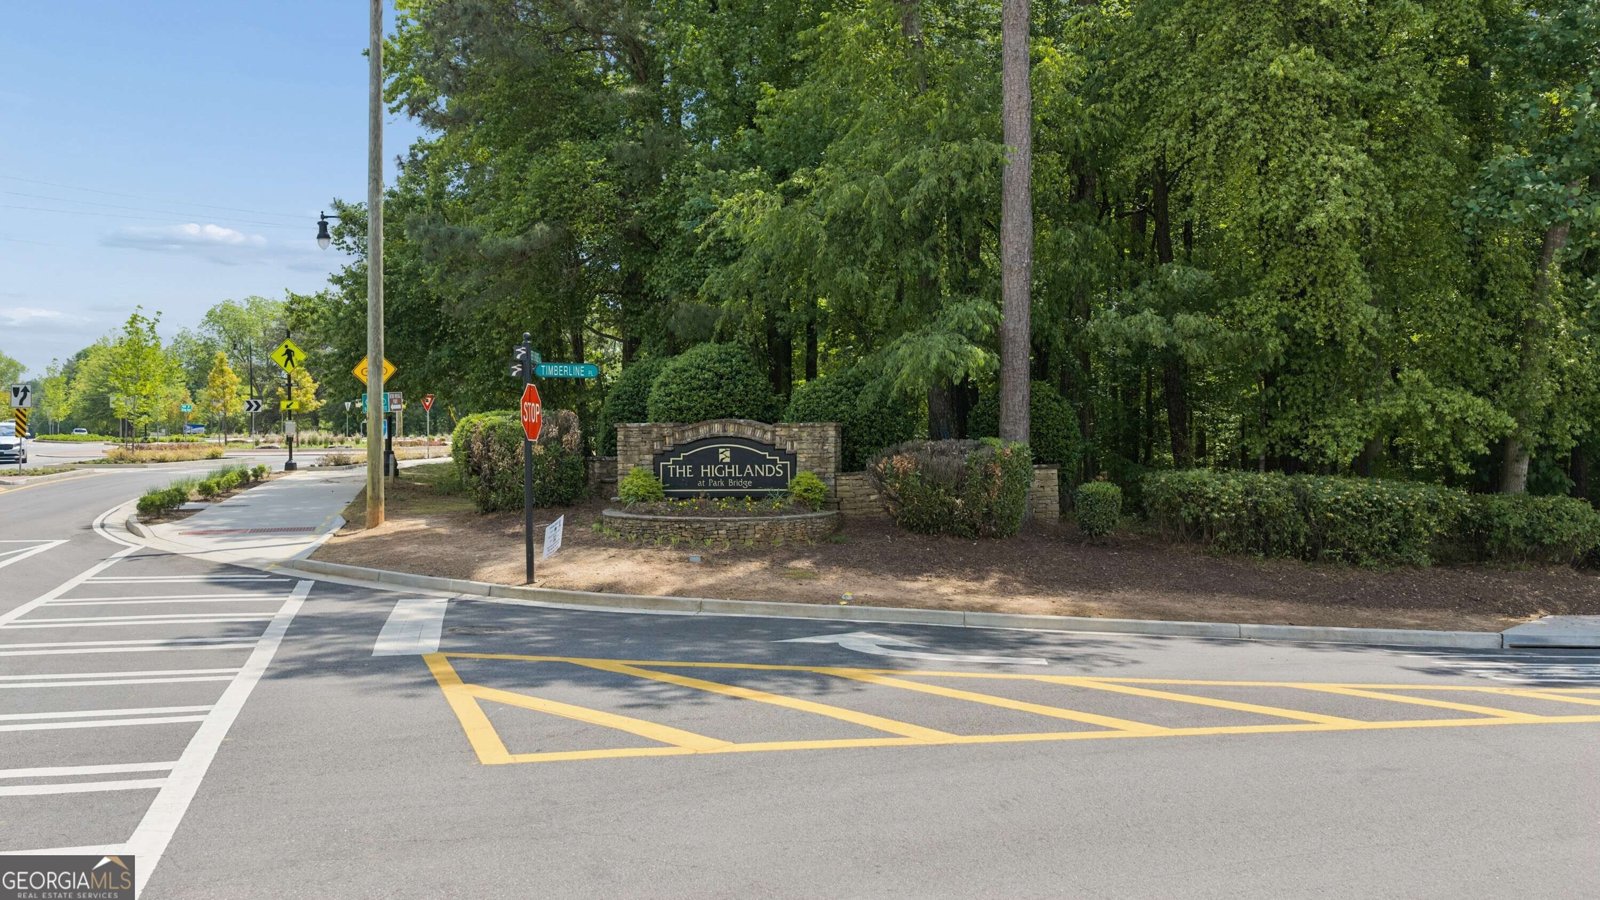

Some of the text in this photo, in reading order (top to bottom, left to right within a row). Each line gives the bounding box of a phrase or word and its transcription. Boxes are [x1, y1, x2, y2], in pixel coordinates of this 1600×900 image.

[541, 365, 585, 377] TIMBERLINE
[523, 401, 540, 423] STOP
[667, 464, 784, 478] THE HIGHLANDS
[697, 479, 753, 489] at Park Bridge
